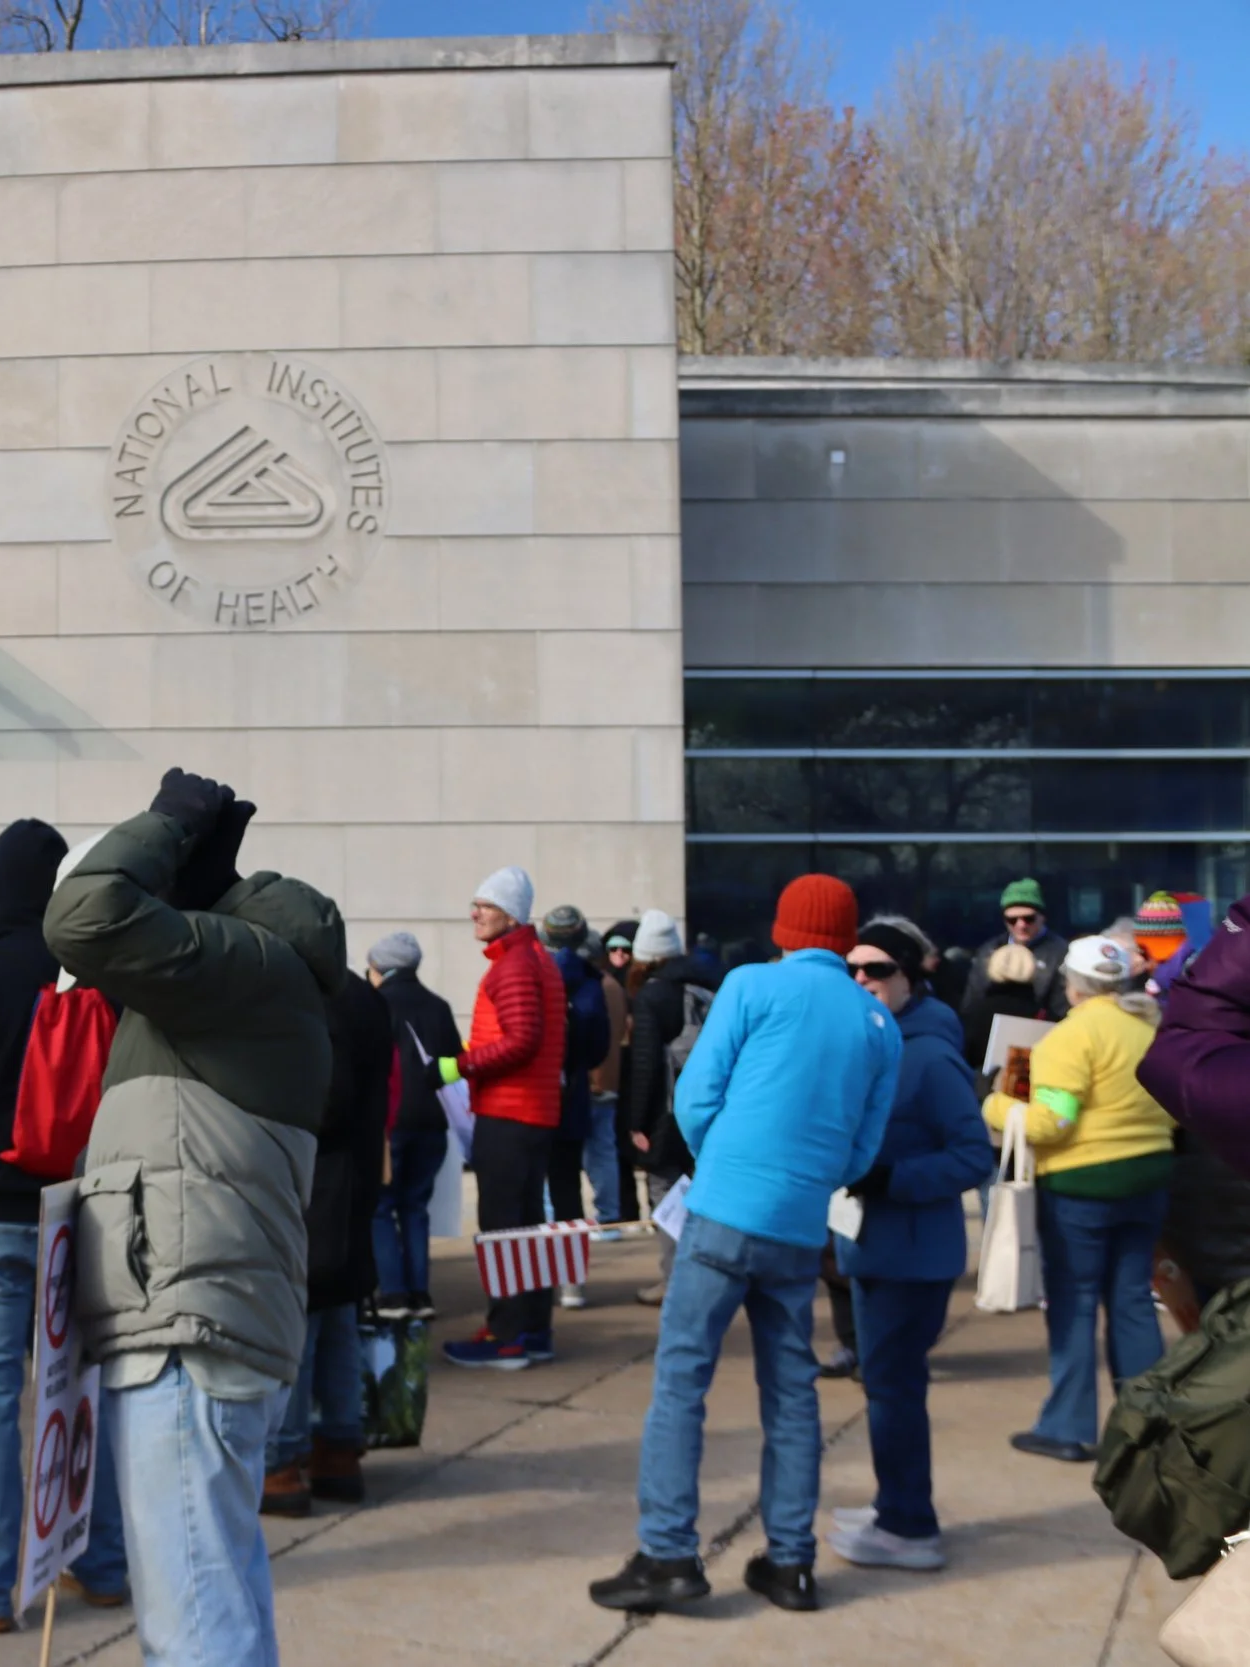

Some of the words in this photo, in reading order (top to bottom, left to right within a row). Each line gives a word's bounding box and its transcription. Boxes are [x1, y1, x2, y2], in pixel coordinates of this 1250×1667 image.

[113, 364, 232, 519] NATIONAL
[266, 361, 383, 535] INSTITUTES
[148, 560, 198, 604] OF
[215, 554, 342, 626] HEALTH
